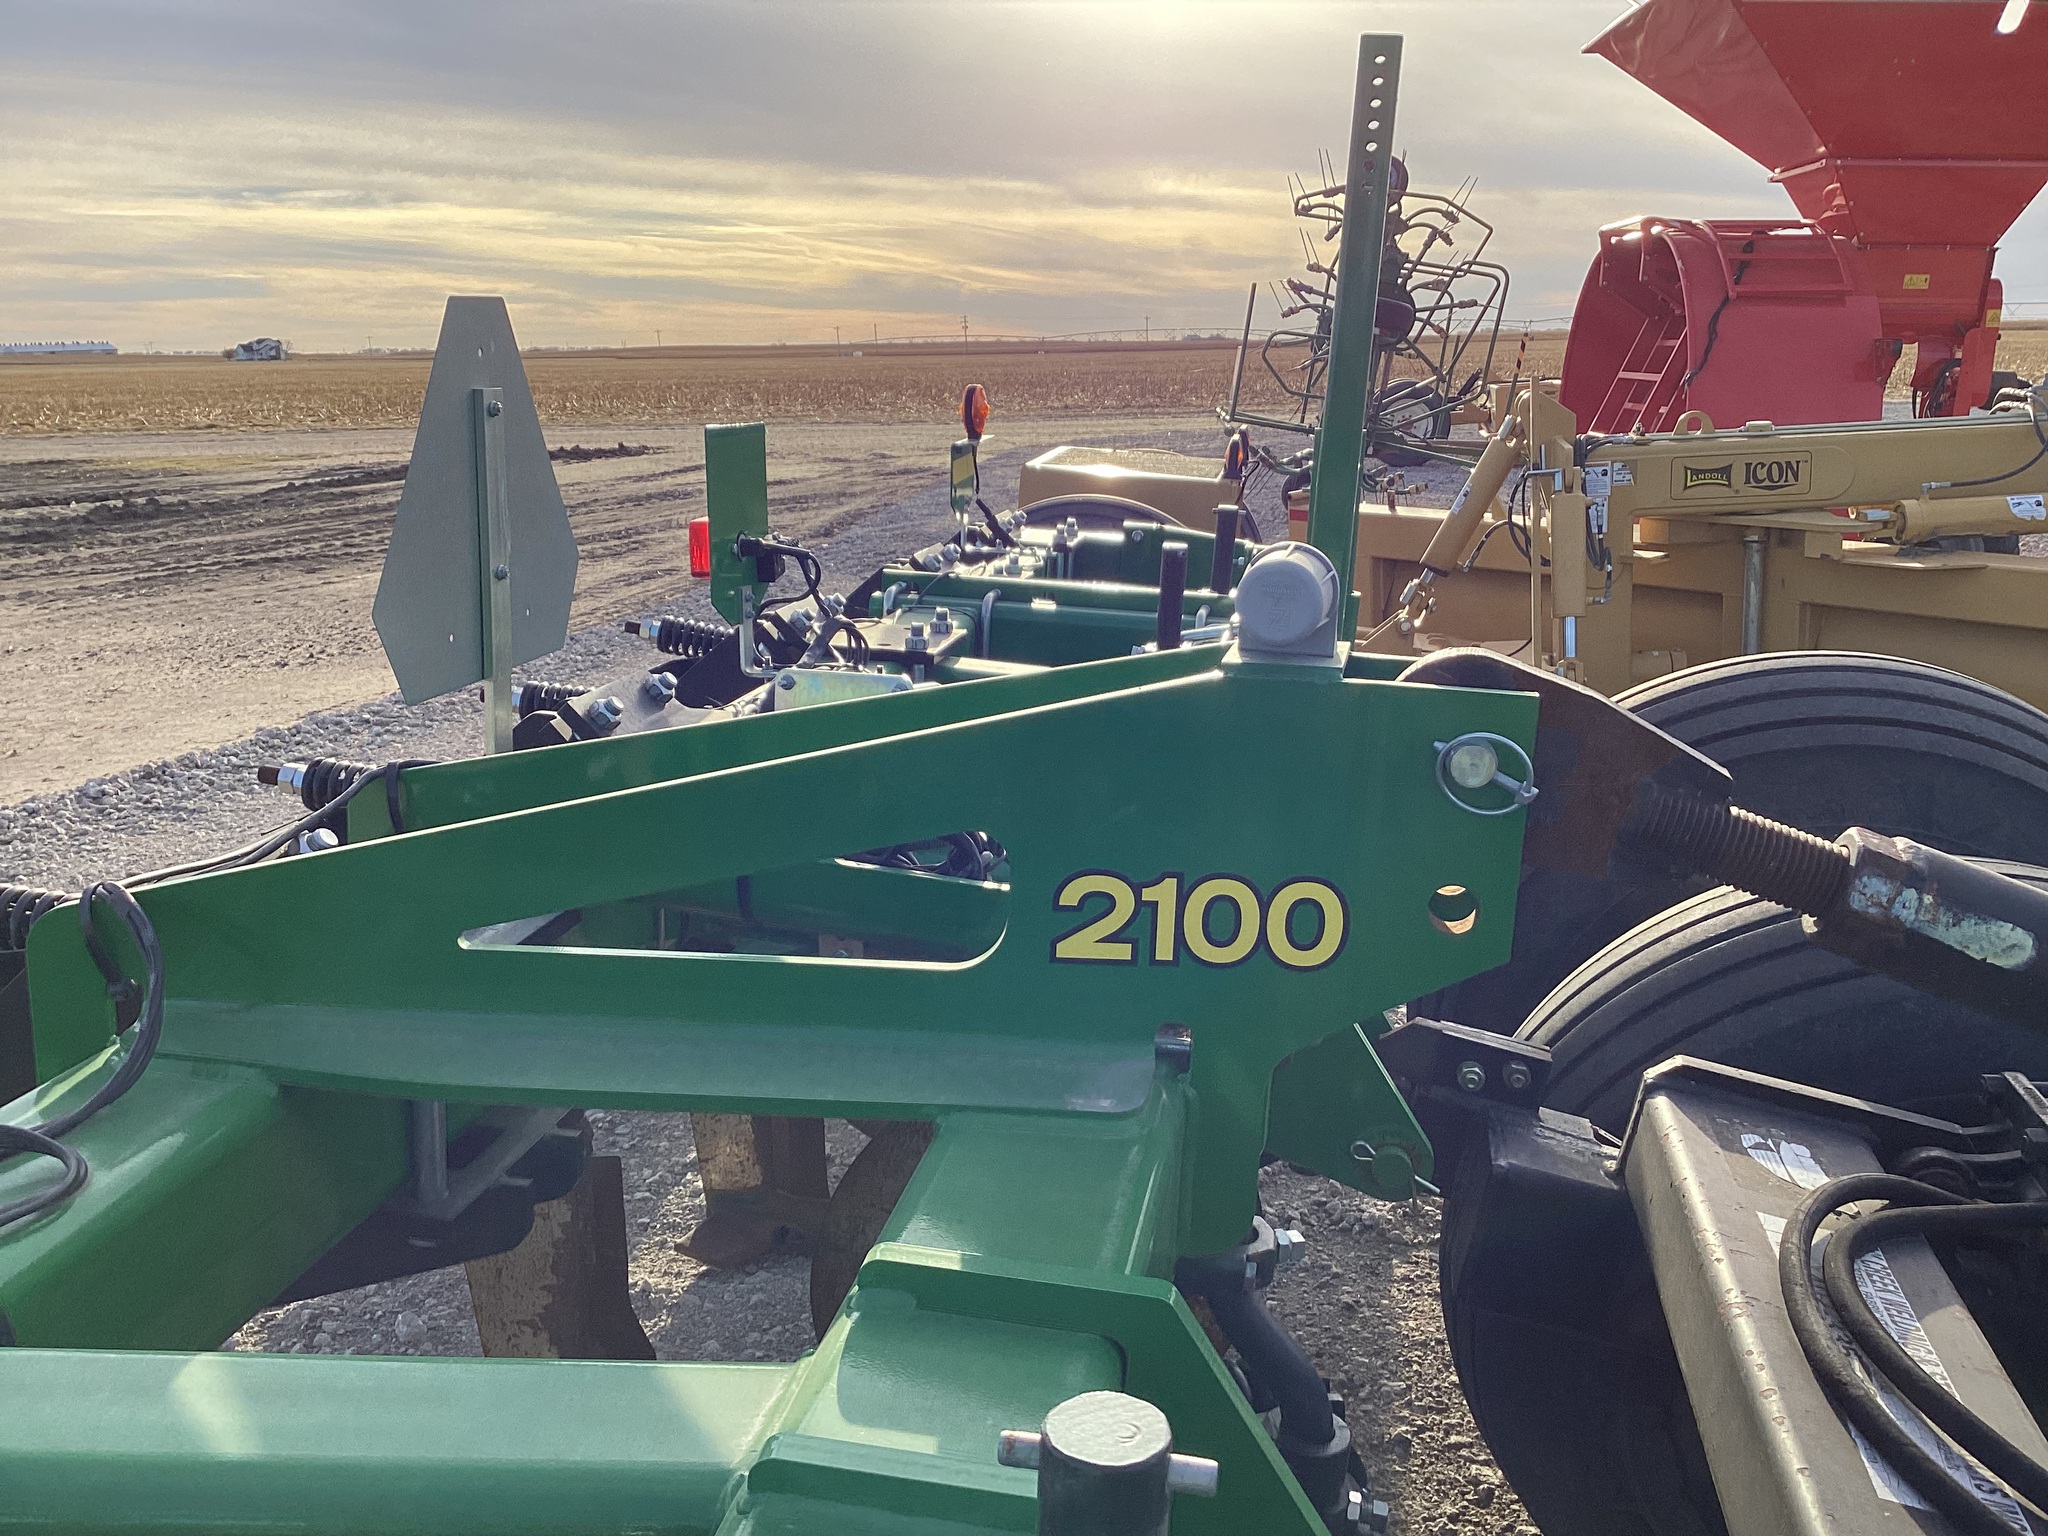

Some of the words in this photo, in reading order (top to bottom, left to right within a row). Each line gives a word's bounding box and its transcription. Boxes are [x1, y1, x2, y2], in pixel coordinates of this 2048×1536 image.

[1687, 469, 1729, 487] LANDOLL
[1744, 460, 1800, 485] ICON
[1050, 869, 1348, 972] 2100
[1860, 1259, 1904, 1299] CREEK
[1878, 1296, 1935, 1355] WELDING
